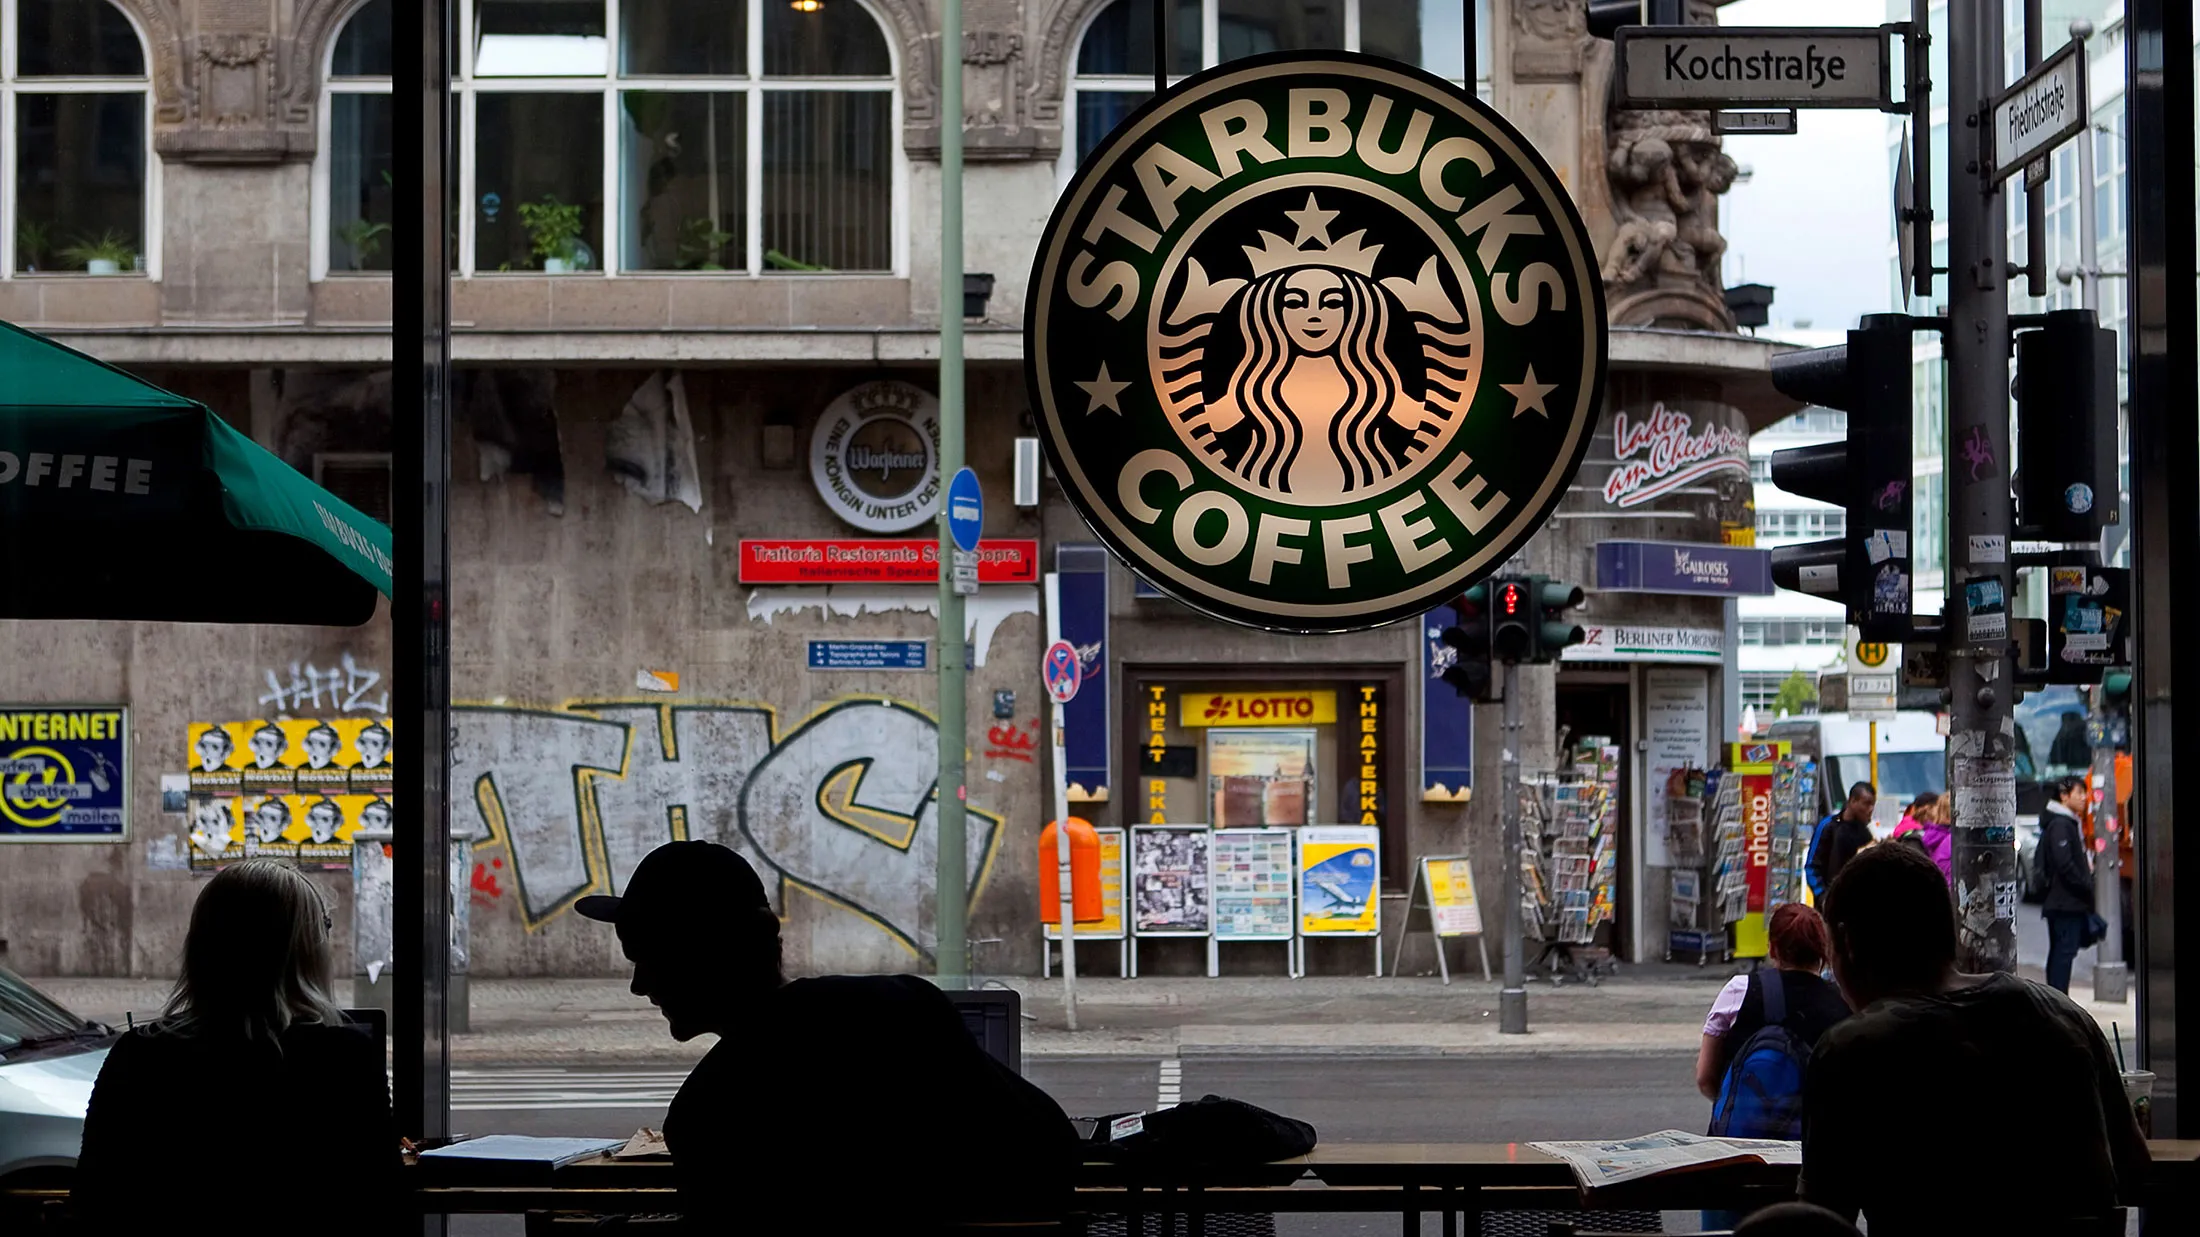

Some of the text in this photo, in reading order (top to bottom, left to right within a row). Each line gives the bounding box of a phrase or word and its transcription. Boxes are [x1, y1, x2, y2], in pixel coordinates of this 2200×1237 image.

[1664, 43, 1846, 90] Kochstraße
[1763, 114, 1776, 127] 14
[2008, 74, 2065, 145] Friedrichstraße
[1066, 88, 1567, 326] STARBUCKS
[1616, 404, 1690, 458] Laden
[0, 451, 153, 495] OFFEE
[825, 417, 941, 520] EINE KÖNIGIN UNTER DEN
[1605, 462, 1652, 502] am
[1117, 448, 1511, 589] COFFEE
[752, 544, 823, 563] Trattoria
[827, 544, 919, 563] Restorante
[1681, 560, 1729, 577] GAULOISES
[799, 566, 881, 577] Italienische
[1614, 628, 1675, 646] BERLINER
[1237, 697, 1315, 719] LOTTO
[0, 712, 120, 741] NTERNET
[0, 760, 37, 773] urfen
[1360, 687, 1377, 825] THEATERKA
[20, 786, 80, 799] chatten
[66, 809, 120, 822] mailen
[1748, 795, 1769, 867] photo
